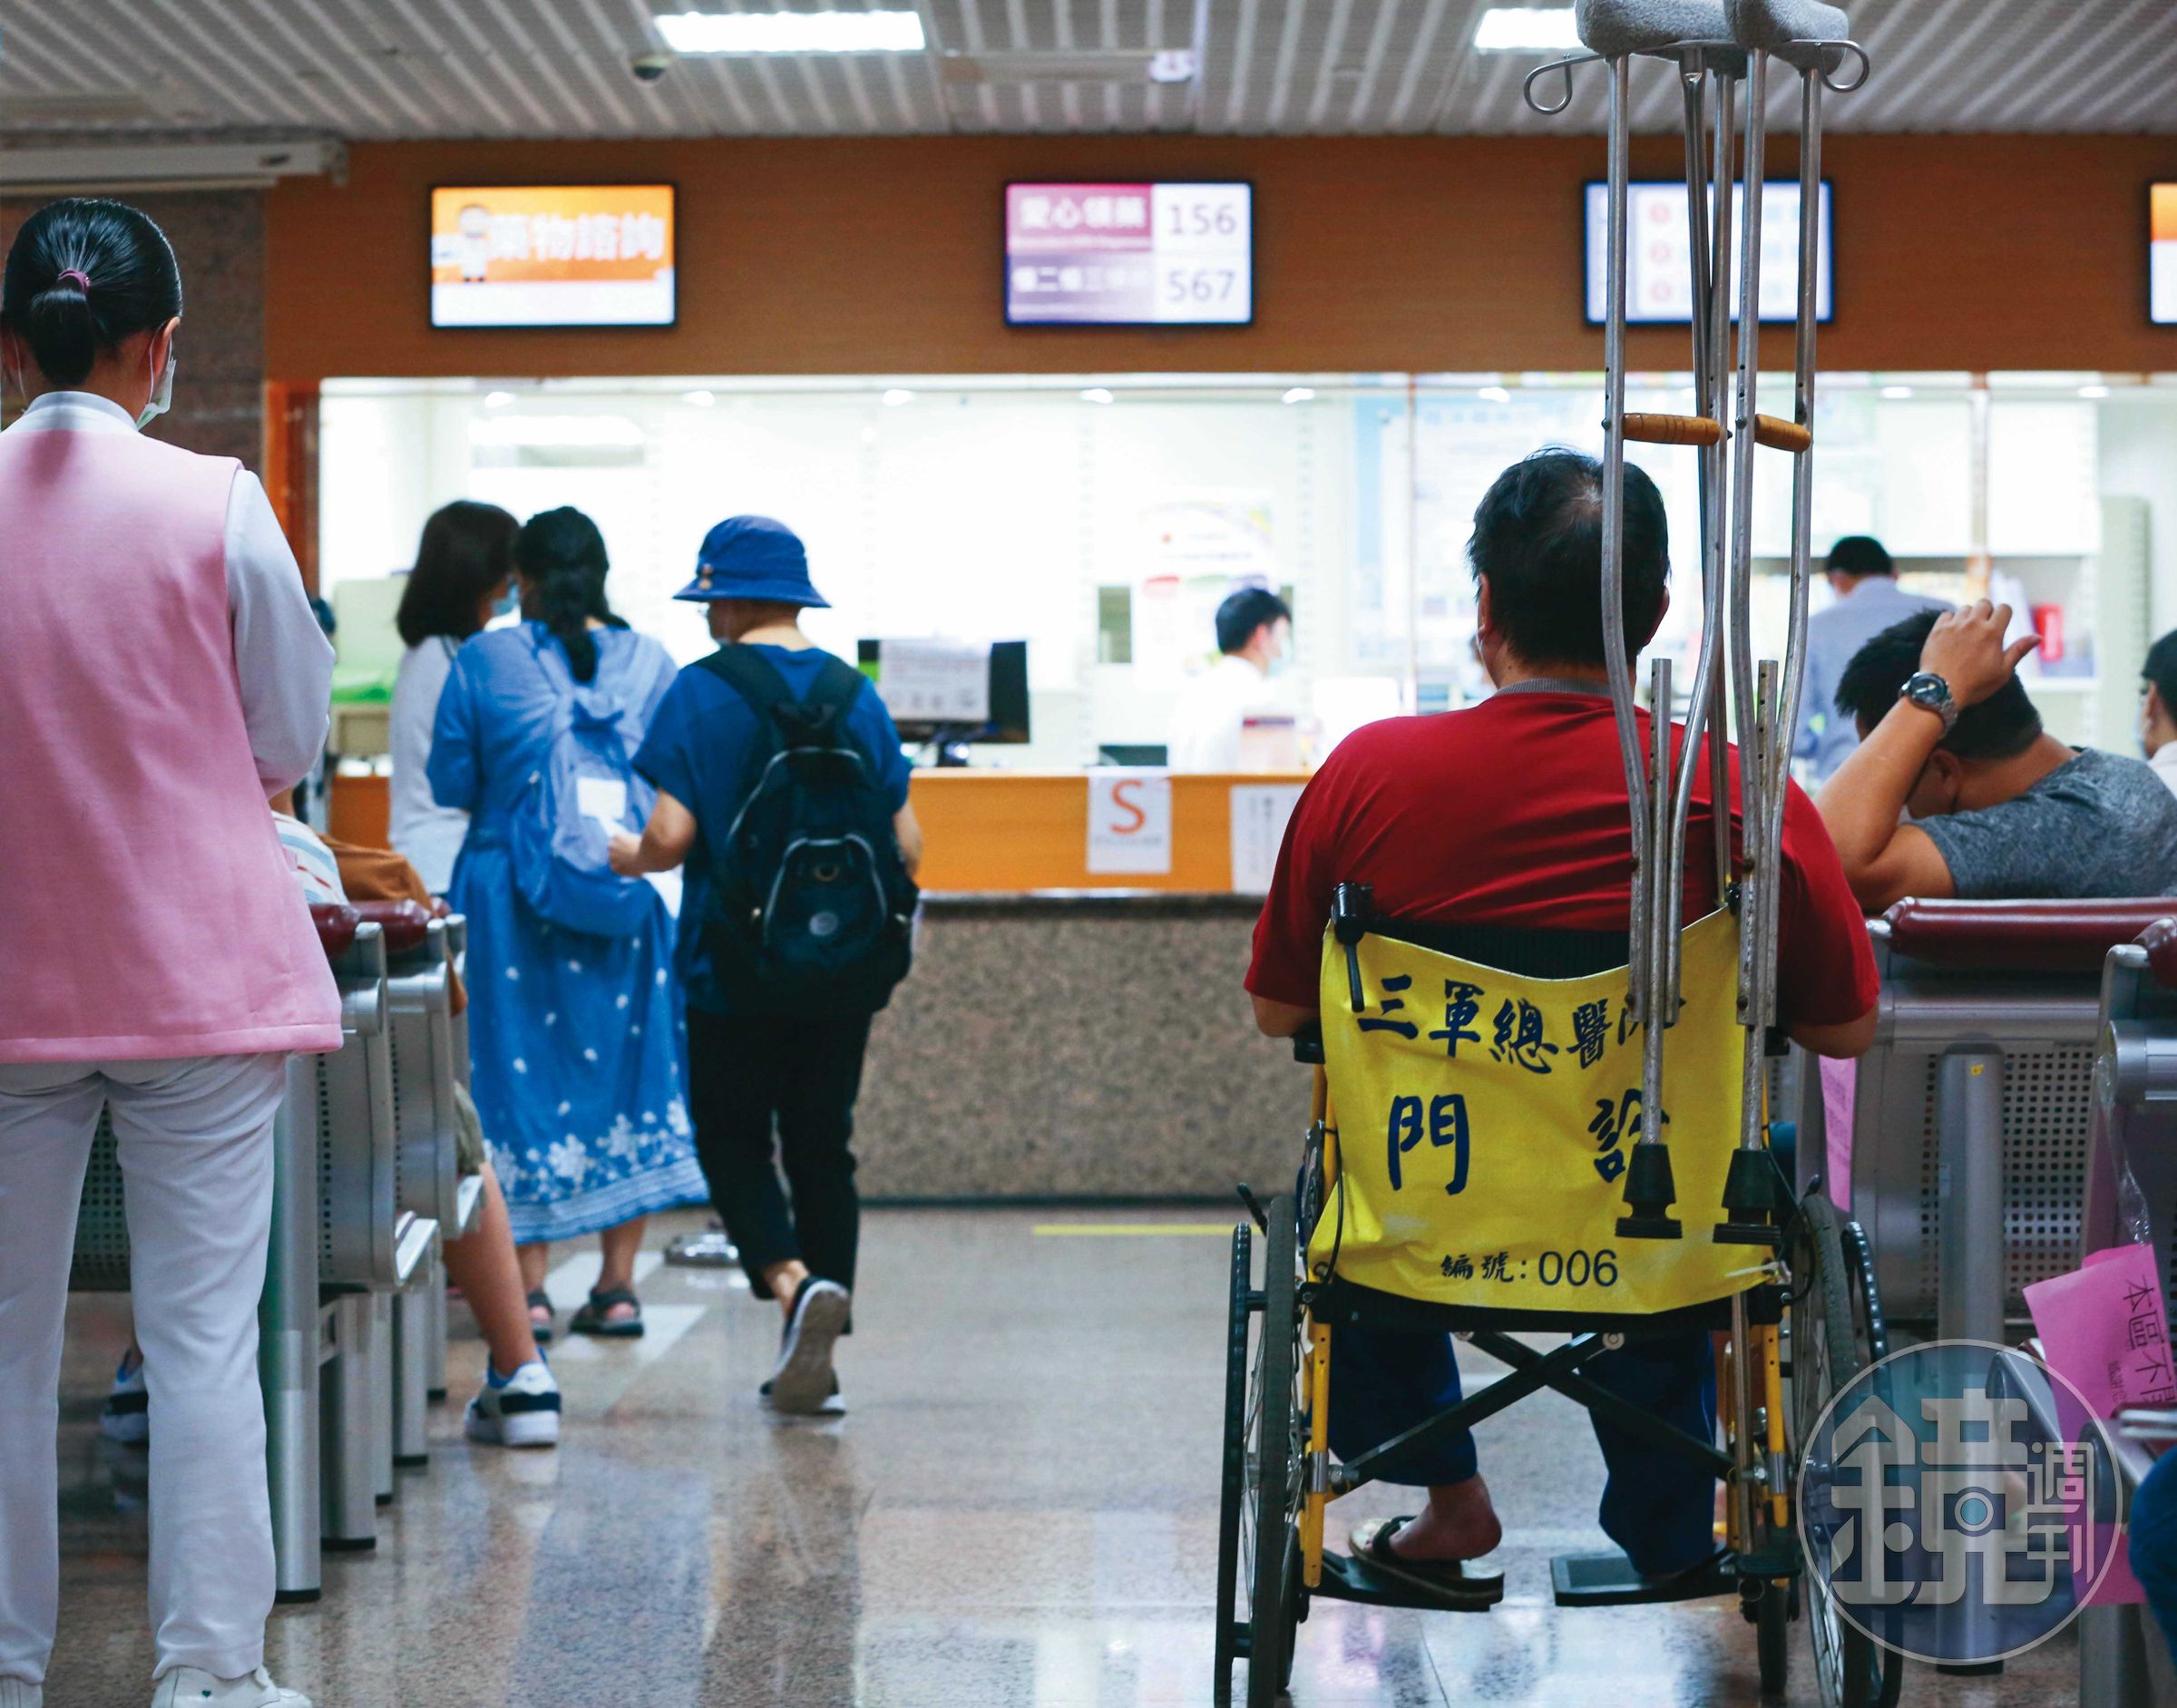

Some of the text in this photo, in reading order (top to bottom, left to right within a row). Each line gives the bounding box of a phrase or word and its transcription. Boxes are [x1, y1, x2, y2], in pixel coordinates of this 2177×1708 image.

[1169, 203, 1236, 236] 156
[1168, 269, 1235, 302] 567
[1109, 778, 1147, 835] S
